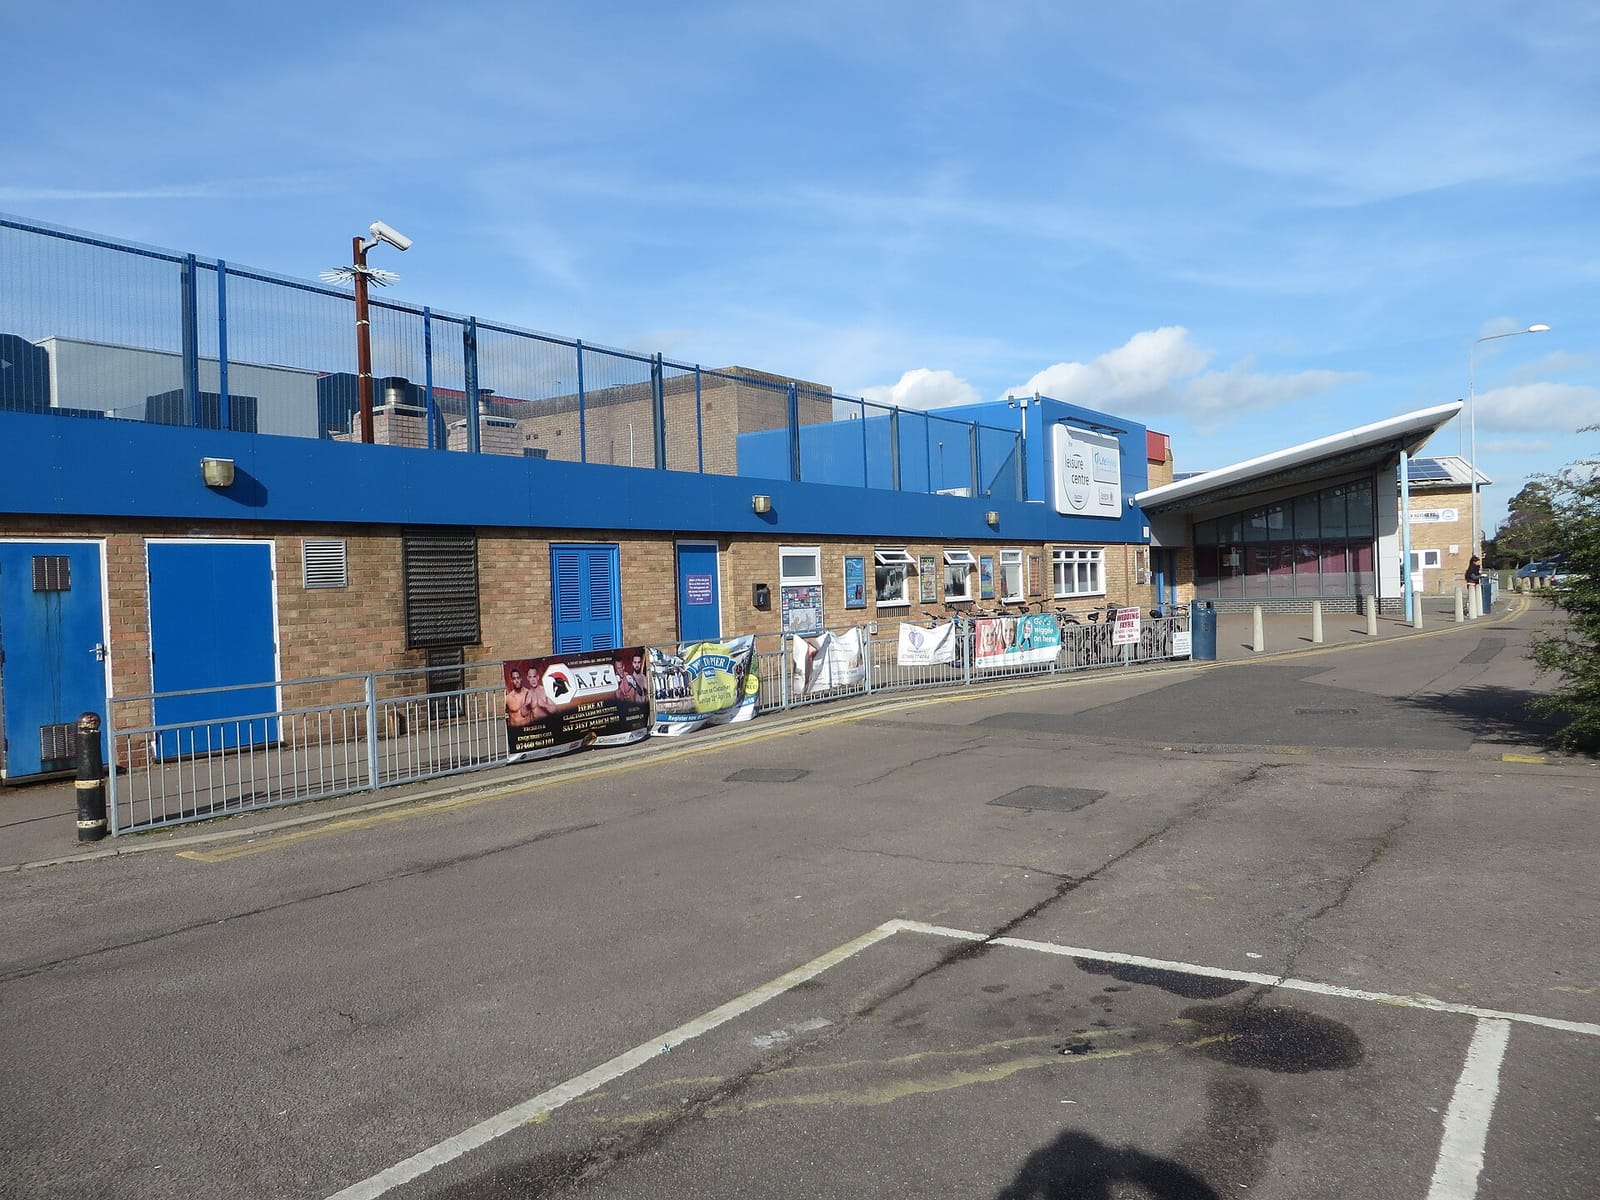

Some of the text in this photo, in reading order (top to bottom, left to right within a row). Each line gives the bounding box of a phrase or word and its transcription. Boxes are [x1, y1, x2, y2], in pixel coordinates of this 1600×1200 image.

[1064, 453, 1084, 470] leisure
[1071, 473, 1090, 486] centre
[1117, 613, 1139, 621] WEDDING
[1042, 635, 1057, 643] here
[578, 701, 605, 712] HERE AT
[668, 714, 688, 722] Register
[562, 724, 575, 732] SAT
